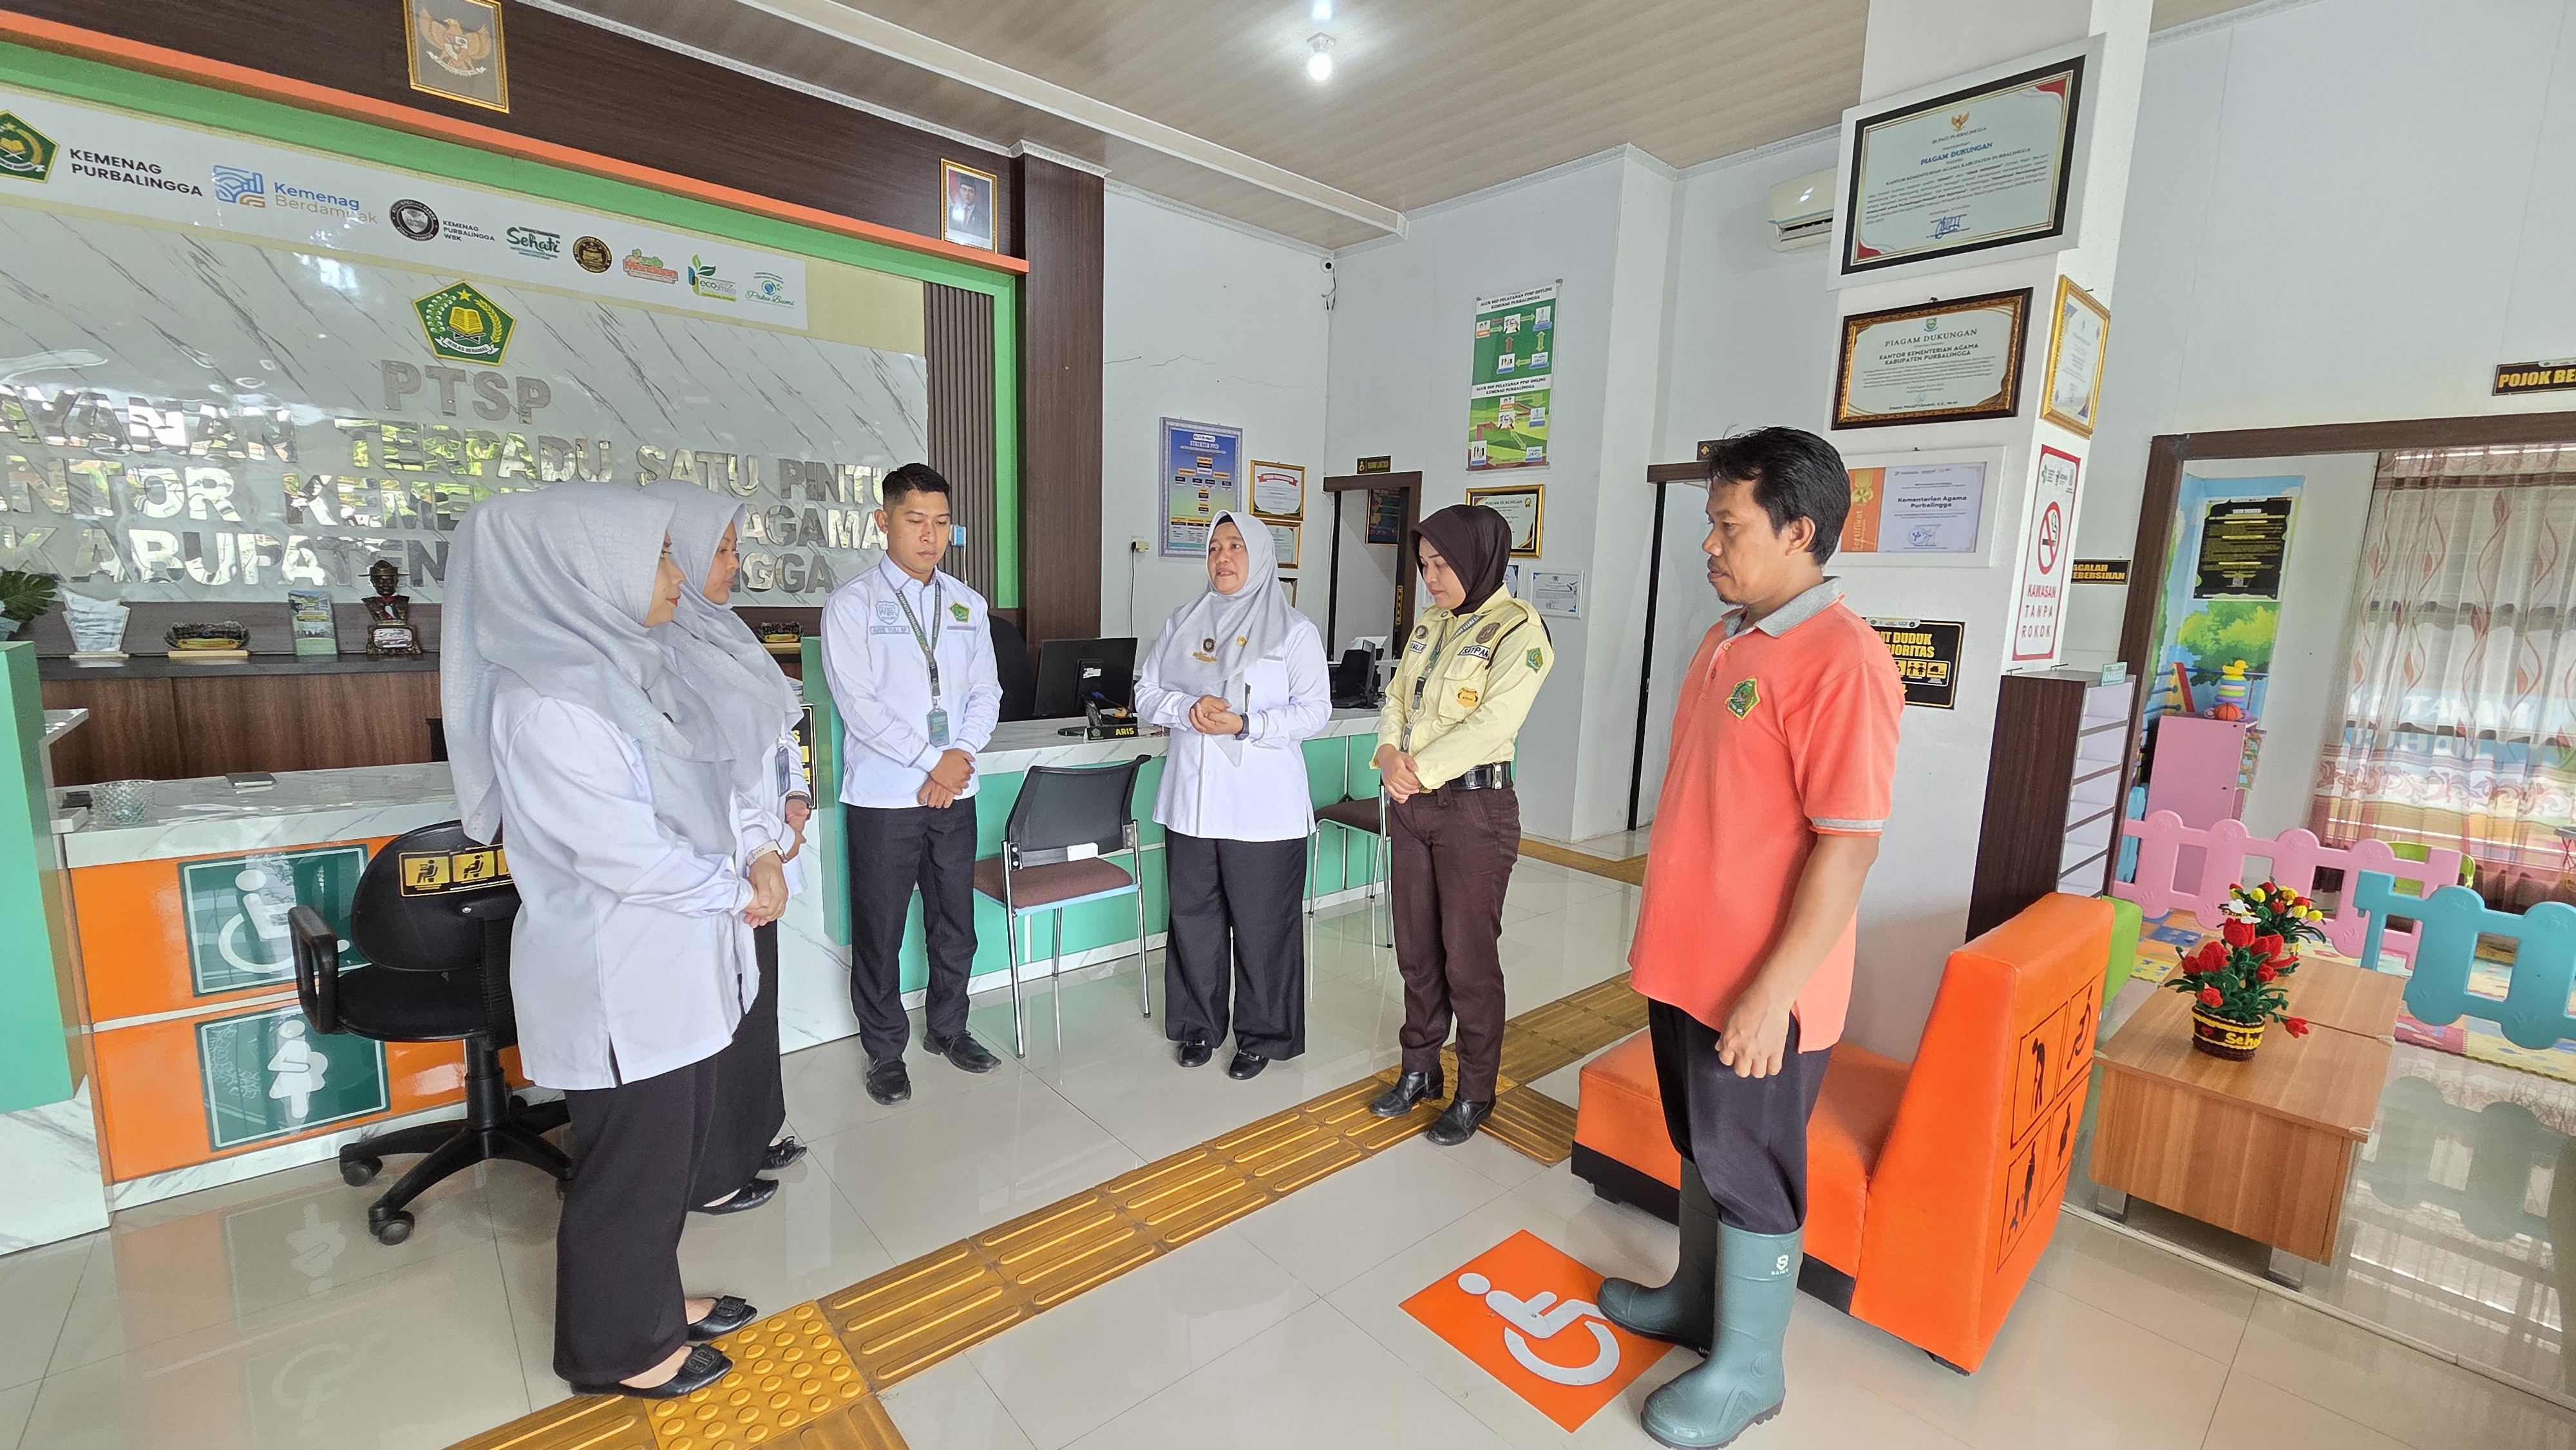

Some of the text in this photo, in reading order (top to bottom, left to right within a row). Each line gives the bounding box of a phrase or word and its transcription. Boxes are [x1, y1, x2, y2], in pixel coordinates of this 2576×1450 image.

[69, 148, 162, 174] KEMENAG
[1920, 142, 1993, 165] PIAGAM DUKUNGAN
[71, 163, 203, 196] PURBALINGGA
[274, 182, 359, 211] Kemenag
[442, 220, 479, 232] KEMENAG
[443, 227, 495, 241] PURBALINGGA
[506, 227, 560, 253] Sehati
[1884, 337, 1920, 347] PIAGAM
[1923, 328, 1978, 342] DUKUNGAN
[1879, 352, 1906, 361] KANTOR
[1908, 346, 1952, 357] KEMENTERIAN
[1954, 343, 1978, 352] AGAMA
[1884, 350, 1971, 365] KABUPATEN PURBALINGGA
[2498, 368, 2576, 388] POJOK BE
[381, 359, 551, 424] PTSP
[334, 415, 612, 482] TERPADU
[636, 445, 759, 496] SATU
[0, 454, 242, 522] NTOR
[739, 504, 888, 550] AGAMA
[2027, 584, 2057, 598] KAWASAN
[2025, 605, 2054, 618] TANPA
[1893, 632, 1933, 645] DUDUK
[2022, 625, 2051, 638] ROKOK
[1115, 728, 1135, 736] ARIS
